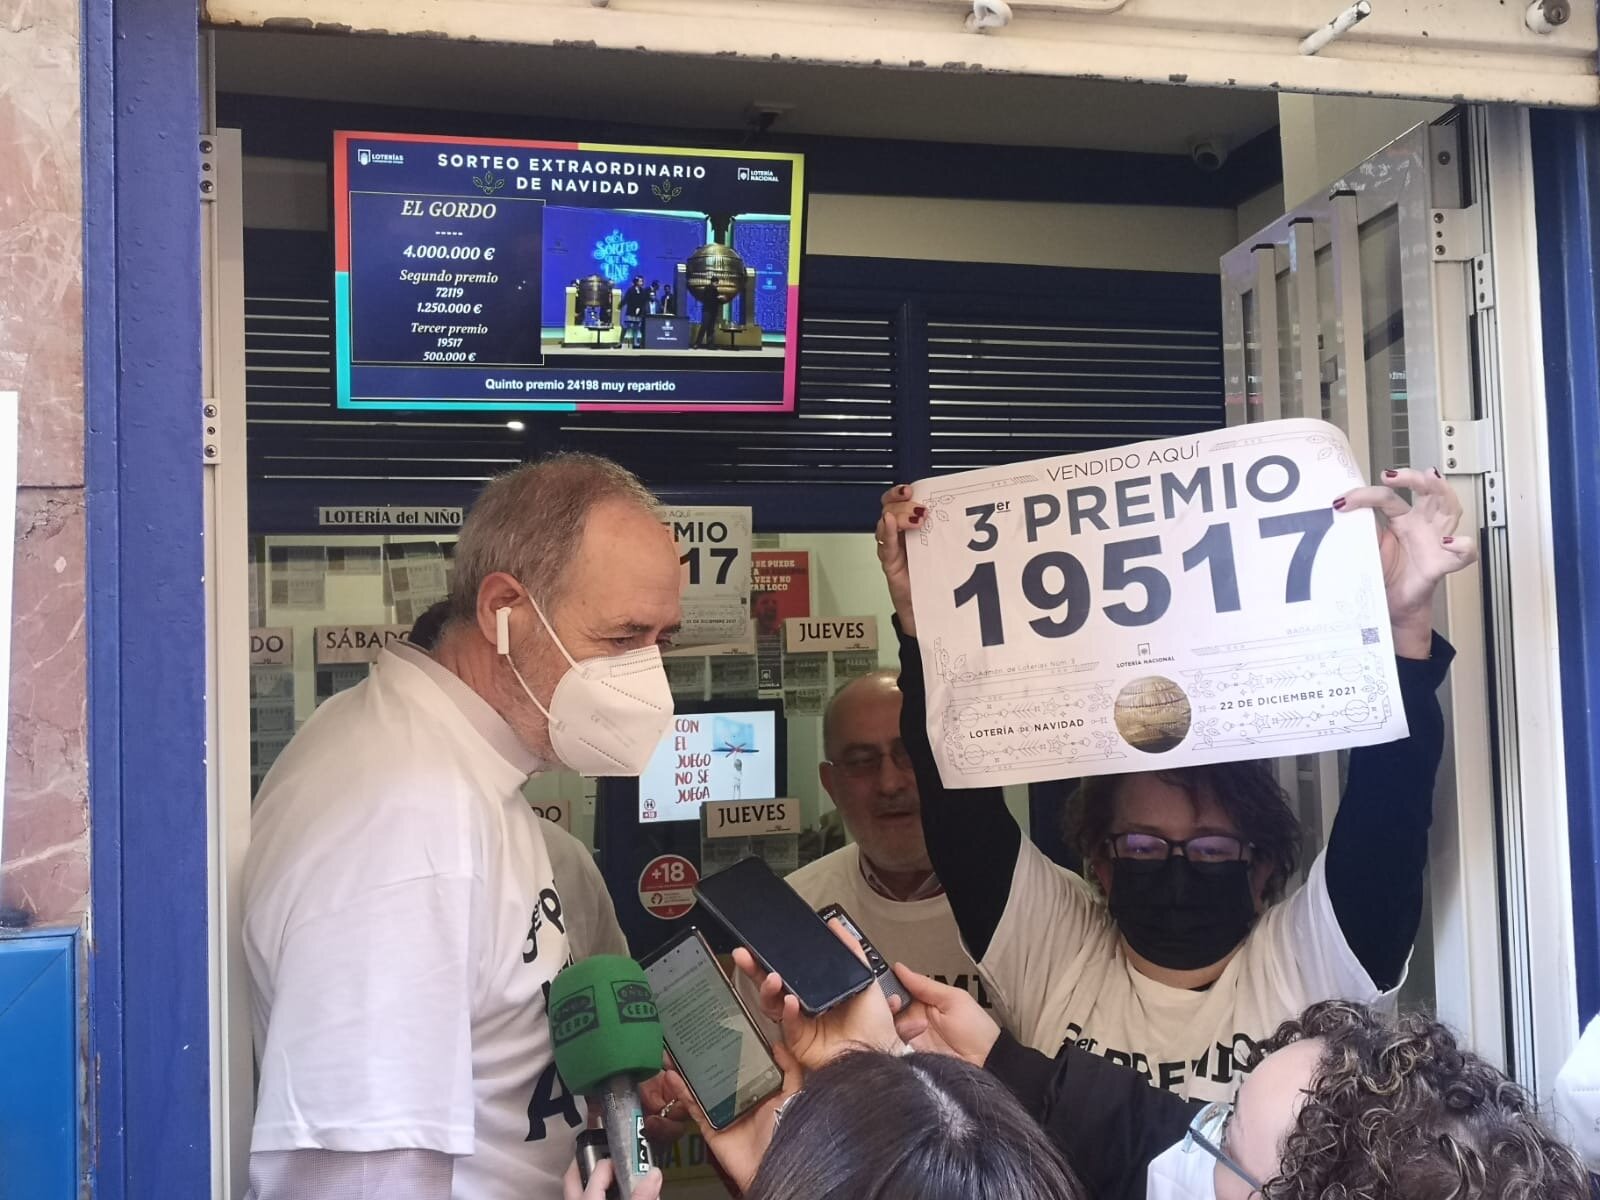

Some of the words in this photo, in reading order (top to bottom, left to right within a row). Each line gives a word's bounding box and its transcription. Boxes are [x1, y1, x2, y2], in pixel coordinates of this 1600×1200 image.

[438, 154, 519, 170] SORTEO
[529, 157, 706, 179] EXTRAORDINARIO
[516, 177, 541, 190] DE
[552, 178, 639, 195] NAVIDAD
[401, 200, 424, 216] EL
[429, 201, 496, 219] GORDO
[403, 245, 481, 261] 4.000.000
[484, 247, 495, 261] €
[399, 269, 453, 285] Segundo
[454, 272, 499, 286] premio
[435, 287, 464, 298] 72119
[417, 302, 471, 314] 1.250.000
[473, 303, 483, 314] €
[411, 322, 447, 333] Tercer
[447, 324, 488, 337] premio
[437, 338, 463, 348] 19517
[423, 352, 466, 362] 500.000
[468, 353, 477, 362] €
[485, 379, 523, 390] Quinto
[526, 380, 565, 392] premio
[567, 380, 599, 390] 24198
[601, 382, 624, 393] muy
[627, 380, 676, 393] repartido
[1047, 453, 1140, 482] VENDIDO
[1147, 440, 1200, 467] AQUÍ
[1023, 454, 1300, 542] PREMIO
[325, 507, 391, 523] LOTERÍA
[396, 511, 419, 524] del
[424, 509, 461, 524] NIÑO
[953, 507, 1335, 647] 19517
[799, 622, 865, 642] JUEVES
[1116, 660, 1142, 669] LOTERÍA
[1144, 655, 1176, 665] NACIONAL
[1220, 702, 1234, 711] 22
[1238, 699, 1254, 708] DE
[1258, 690, 1324, 706] DICIEMBRE
[1329, 686, 1357, 698] 2021
[674, 718, 699, 733] CON
[969, 725, 1015, 739] LOTERÍA
[1034, 718, 1085, 732] NAVIDAD
[674, 736, 686, 751] EL
[675, 753, 712, 769] JUEGO
[674, 771, 693, 786] NO
[697, 769, 709, 784] SE
[675, 786, 710, 804] JUEGA
[718, 804, 786, 827] JUEVES
[651, 861, 685, 883] +18
